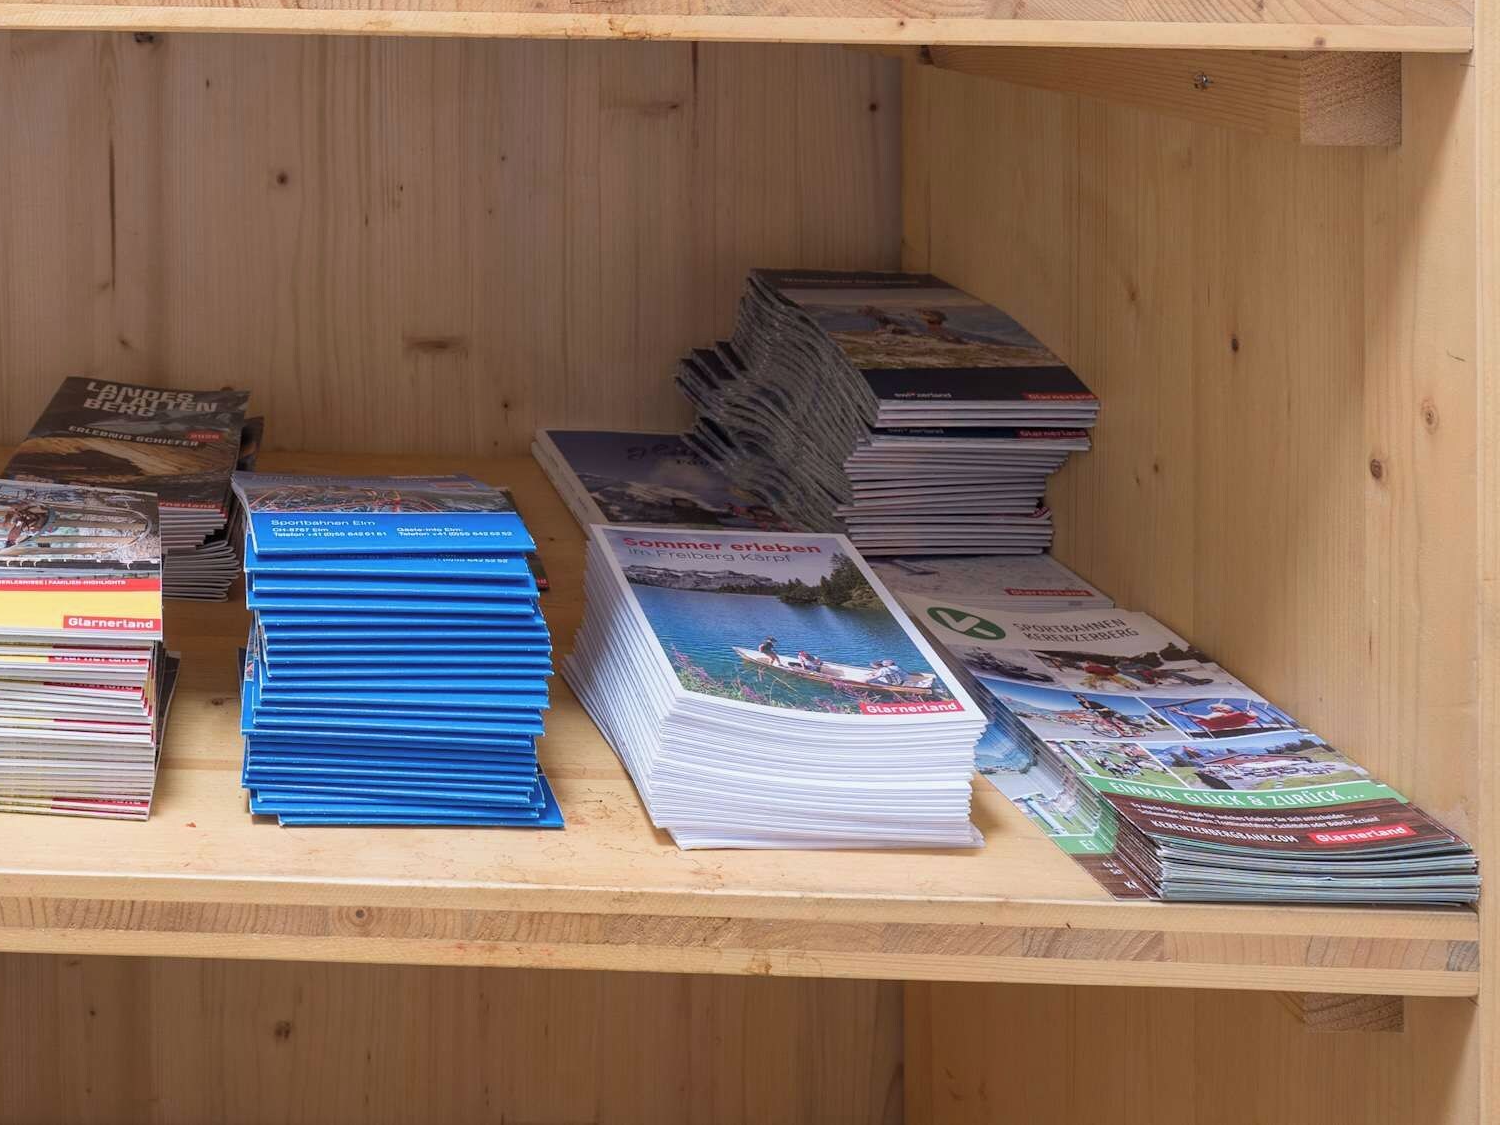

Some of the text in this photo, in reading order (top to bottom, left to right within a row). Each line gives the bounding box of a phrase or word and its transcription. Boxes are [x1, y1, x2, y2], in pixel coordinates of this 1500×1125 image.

[87, 382, 195, 402] LANDES
[84, 398, 155, 417] BERG
[98, 392, 218, 412] PLATTEN
[69, 425, 132, 440] ERLEBNIS
[136, 436, 200, 447] SCHIEFER
[623, 537, 821, 553] Sommer erleben
[654, 549, 735, 562] Freiberg
[739, 551, 790, 563] Kärpf
[68, 617, 154, 629] Glarnerland
[1013, 618, 1127, 634] SPORTBAHNEN
[1024, 628, 1139, 643] KERENZERBERG
[865, 702, 957, 715] Glarnerland
[1109, 782, 1180, 801] EINMAL
[1184, 792, 1244, 806] GLÜCK
[1247, 796, 1267, 806] &
[1316, 827, 1405, 842] Glarnerland
